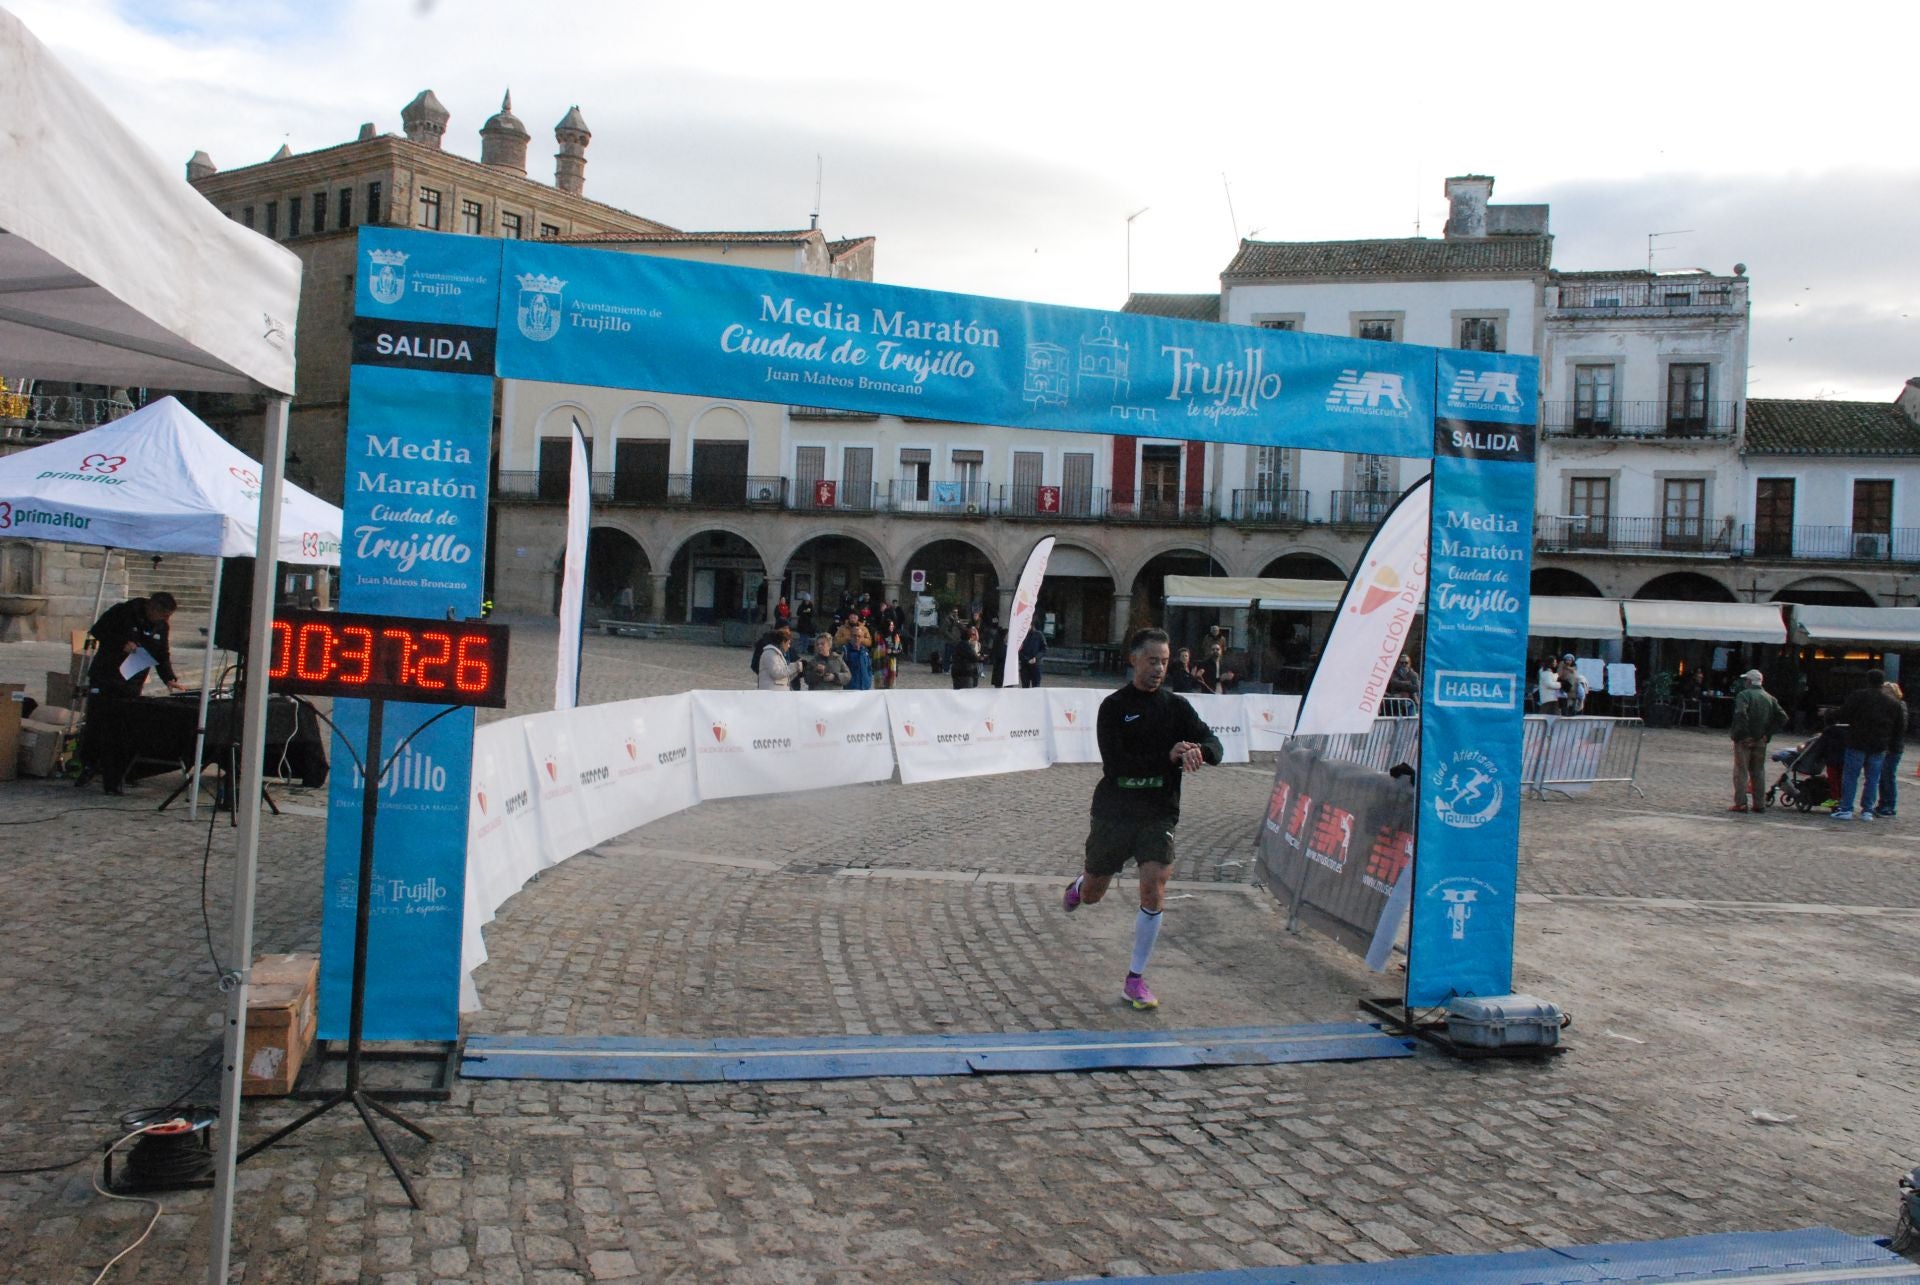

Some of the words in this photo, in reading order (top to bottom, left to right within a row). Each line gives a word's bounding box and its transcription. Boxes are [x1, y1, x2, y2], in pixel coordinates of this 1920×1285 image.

[413, 270, 475, 282] Ayuntamiento
[476, 275, 487, 283] de
[412, 281, 461, 296] Trujillo
[572, 299, 646, 317] Ayuntamiento
[649, 308, 662, 318] de
[570, 313, 631, 333] Trujillo
[760, 295, 861, 333] Media
[870, 308, 999, 348] Maratón
[376, 334, 472, 361] SALIDA
[720, 324, 827, 359] Ciudad
[832, 339, 869, 365] de
[876, 341, 975, 383] Trujillo
[765, 367, 799, 382] Juan
[803, 370, 854, 388] Mateos
[859, 377, 922, 395] Broncano
[1161, 345, 1282, 410] Trujillo
[1187, 398, 1200, 416] te
[366, 435, 472, 464] Media
[1452, 431, 1519, 452] SALIDA
[36, 469, 127, 486] primaflor
[357, 472, 477, 499] Maratón
[13, 508, 91, 530] primaflor
[371, 504, 433, 525] Ciudad
[436, 509, 457, 525] de
[1445, 510, 1519, 533] Media
[354, 525, 472, 573] Trujillo
[1440, 539, 1523, 561] Maratón
[357, 575, 380, 585] Juan
[383, 576, 417, 587] Mateos
[421, 578, 467, 590] Broncano
[1448, 565, 1491, 581] Ciudad
[1493, 570, 1508, 583] de
[1437, 583, 1519, 620] Trujillo
[1359, 607, 1410, 714] DIPUTACIÓN
[1401, 582, 1420, 603] DE
[1446, 681, 1504, 698] HABLA
[1432, 760, 1448, 786] Club
[388, 877, 447, 902] Trujillo
